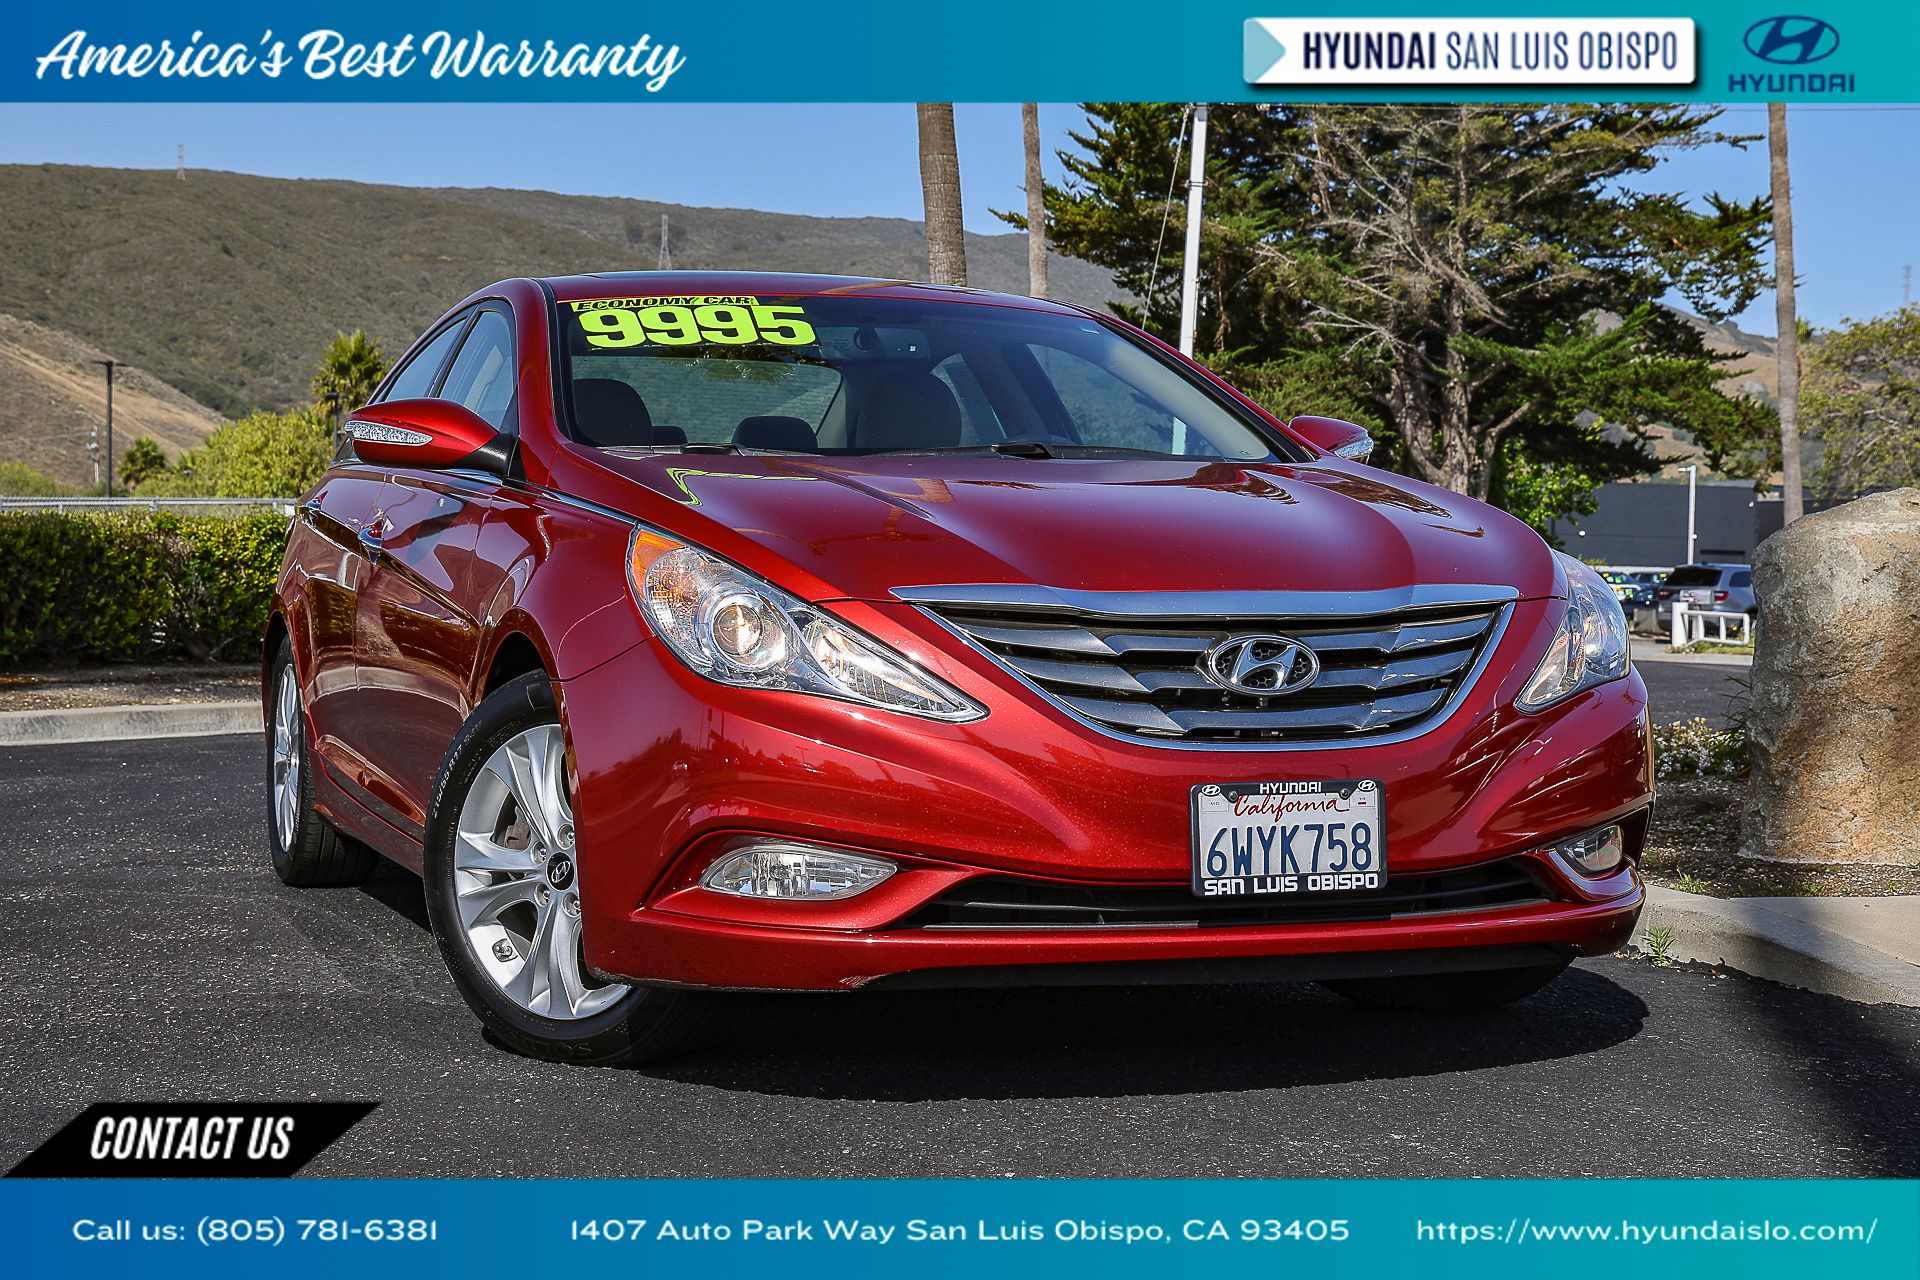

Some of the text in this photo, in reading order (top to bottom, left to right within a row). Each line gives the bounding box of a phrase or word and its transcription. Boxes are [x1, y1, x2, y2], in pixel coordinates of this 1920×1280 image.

[577, 296, 751, 311] ECONOMY CAR
[578, 305, 816, 348] 9995
[1259, 781, 1322, 795] HYUNDAI
[1233, 793, 1350, 823] California
[1206, 822, 1372, 877] 6WYK758
[1204, 873, 1379, 896] SAN LUIS OBISPO
